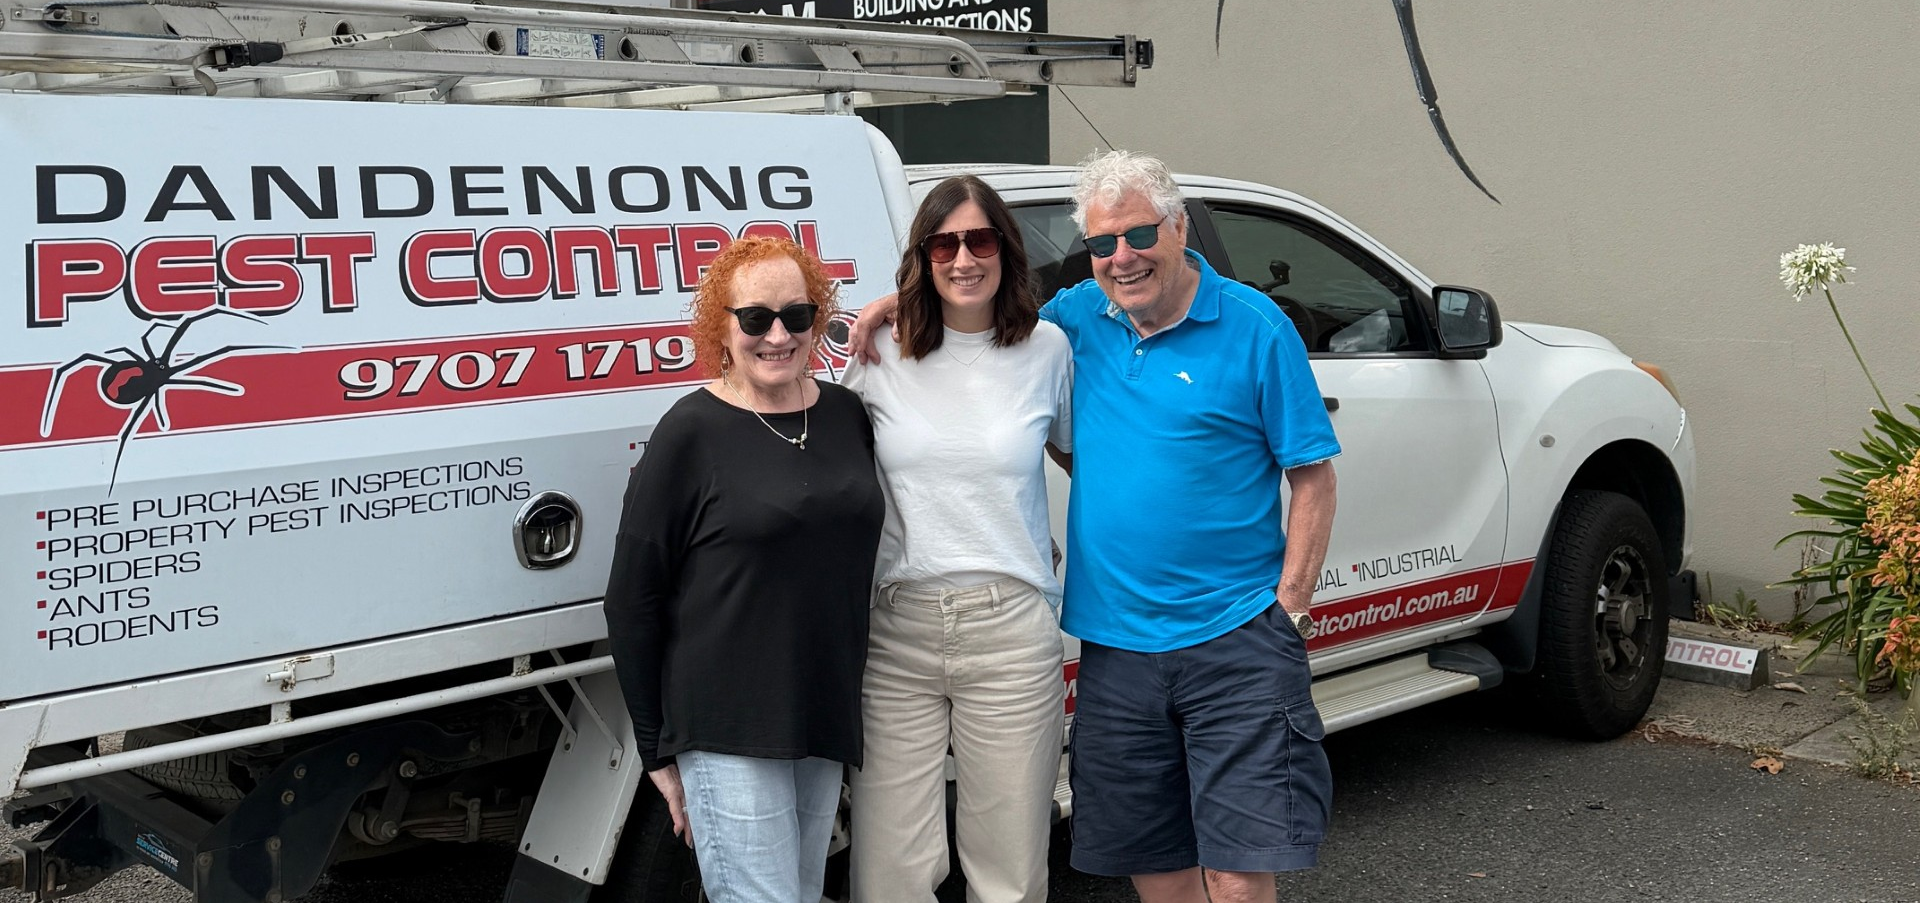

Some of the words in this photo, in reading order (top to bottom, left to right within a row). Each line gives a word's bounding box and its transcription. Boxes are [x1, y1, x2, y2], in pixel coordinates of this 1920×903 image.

[35, 165, 813, 224] DANDENONG
[26, 231, 376, 328] PEST
[338, 346, 537, 400] 9707
[557, 335, 696, 381] 1719
[48, 502, 119, 531] PRE
[133, 480, 320, 521] PURCHASE
[331, 456, 524, 498] INSPECTIONS
[48, 518, 237, 561] PROPERTY
[248, 506, 330, 536] PEST
[340, 481, 532, 524] INSPECTIONS
[48, 551, 201, 591] SPIDERS
[1313, 567, 1348, 593] IAL
[1357, 545, 1463, 583] INDUSTRIAL
[49, 605, 219, 651] RODENTS
[50, 587, 150, 621] ANTS
[1667, 641, 1747, 669] NTROL
